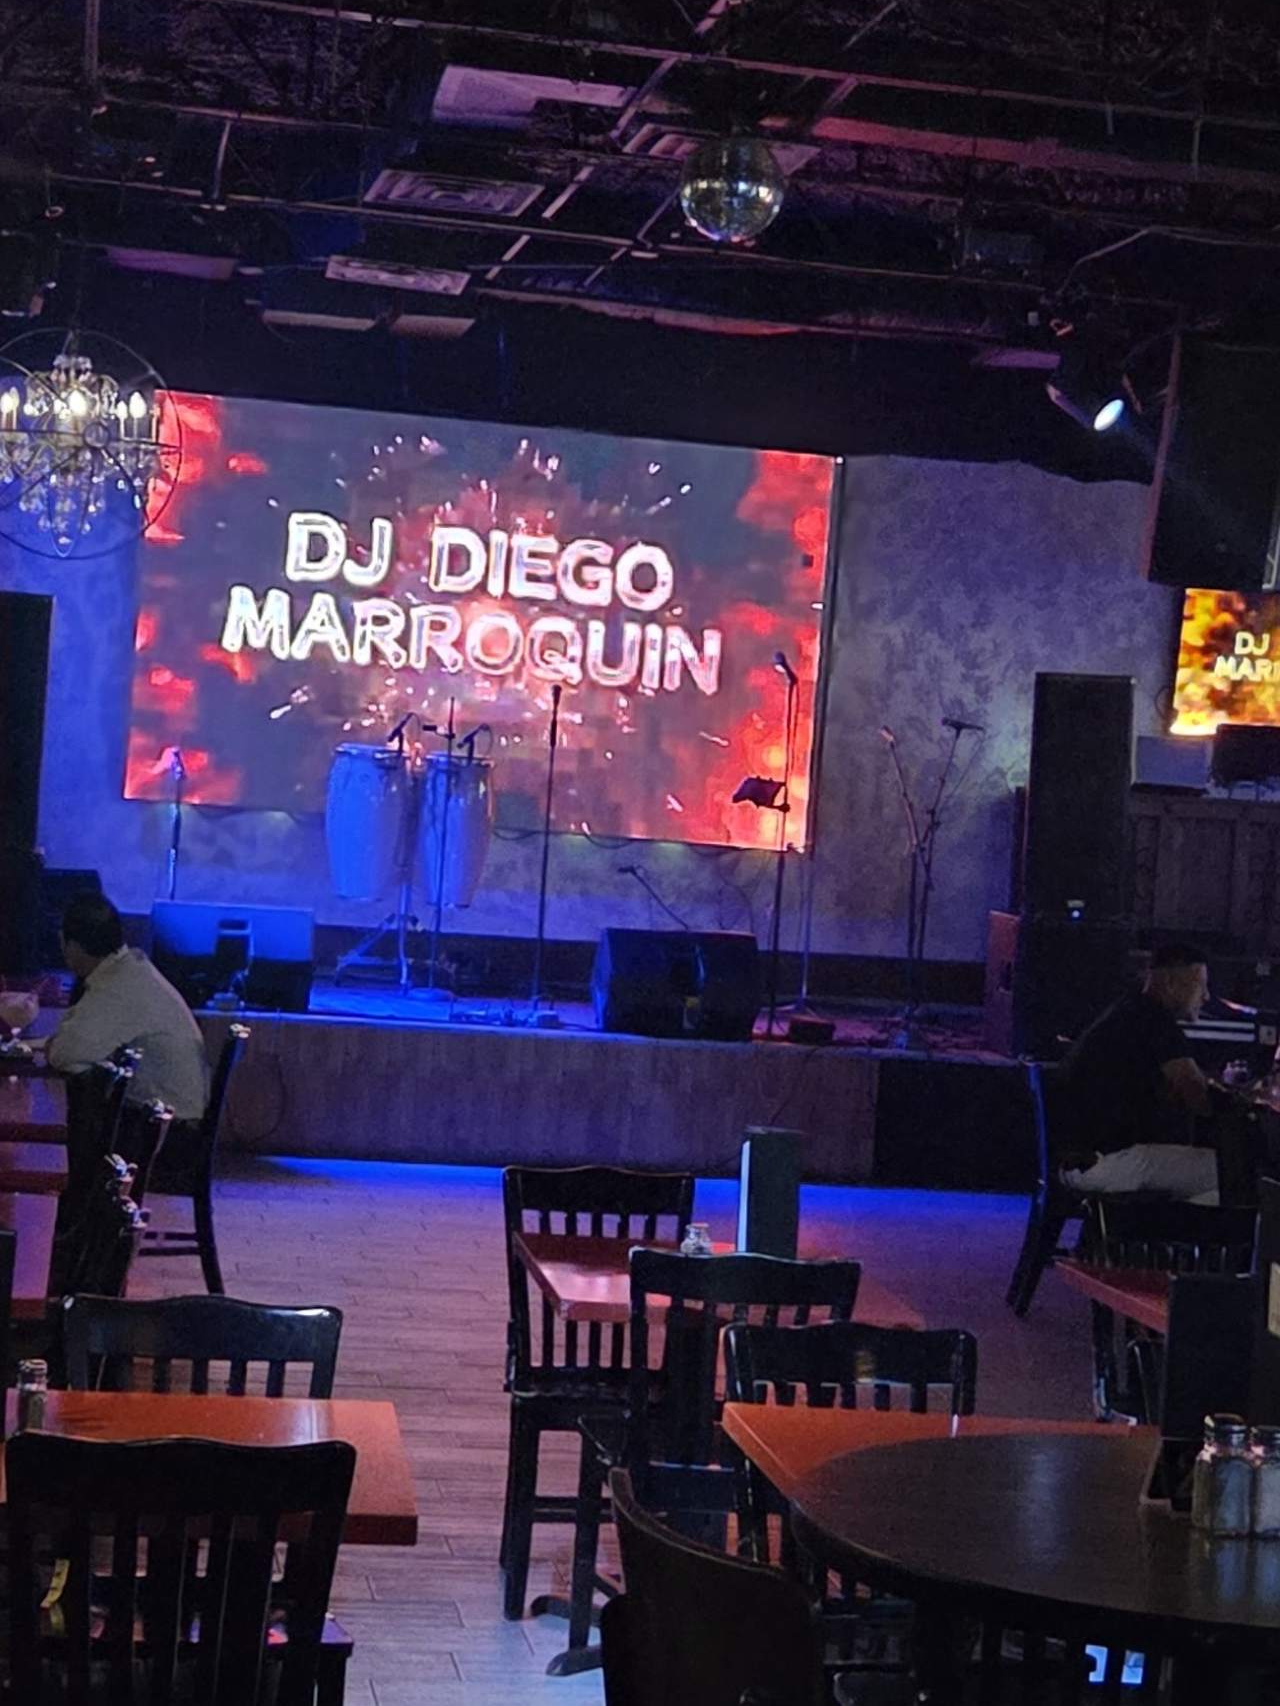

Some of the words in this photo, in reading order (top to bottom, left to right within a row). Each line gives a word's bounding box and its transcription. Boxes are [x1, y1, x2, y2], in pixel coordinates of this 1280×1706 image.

[285, 512, 394, 586] DJ
[429, 526, 676, 611] DIEGO
[222, 586, 722, 695] MARROQUIN
[1234, 631, 1270, 655] DJ
